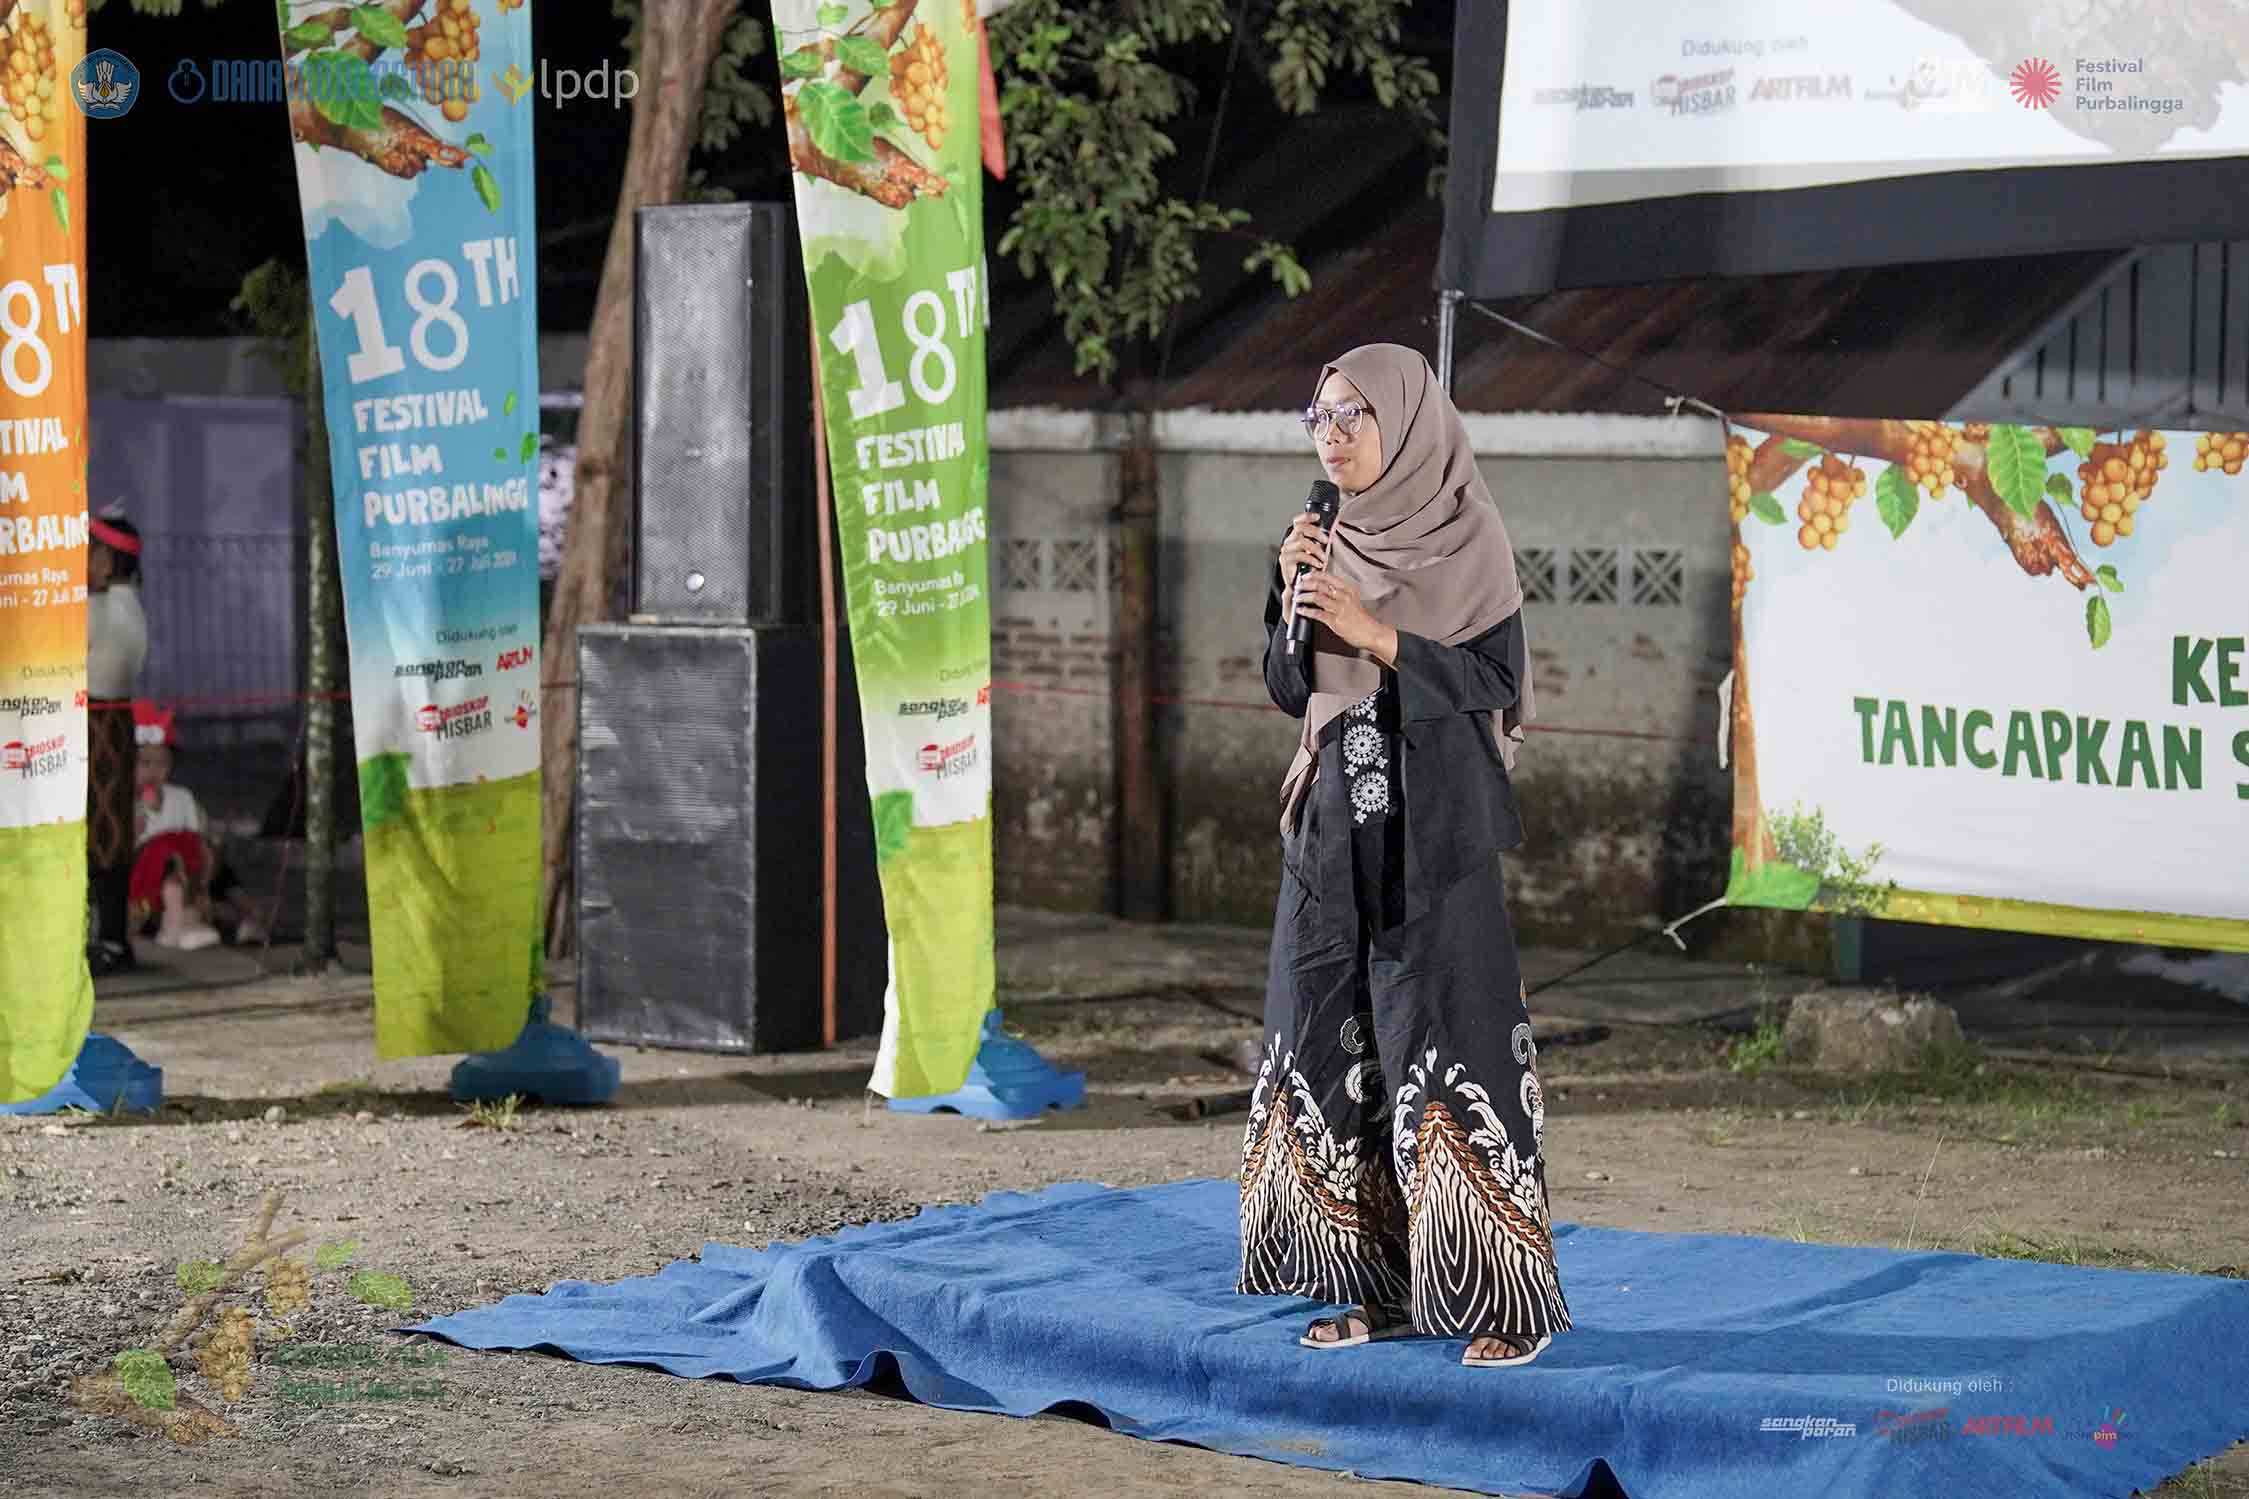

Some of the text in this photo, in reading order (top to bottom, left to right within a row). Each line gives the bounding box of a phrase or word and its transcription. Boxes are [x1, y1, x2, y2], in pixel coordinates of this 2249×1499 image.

[354, 389, 489, 433] FESTIVAL
[358, 443, 444, 481] FILM
[863, 479, 941, 516] FILM
[370, 539, 454, 562] Banyumas
[396, 560, 433, 579] Juni
[902, 597, 936, 616] Juni
[434, 710, 494, 740] MISBAR
[1853, 697, 2203, 790] TANCAPKAN
